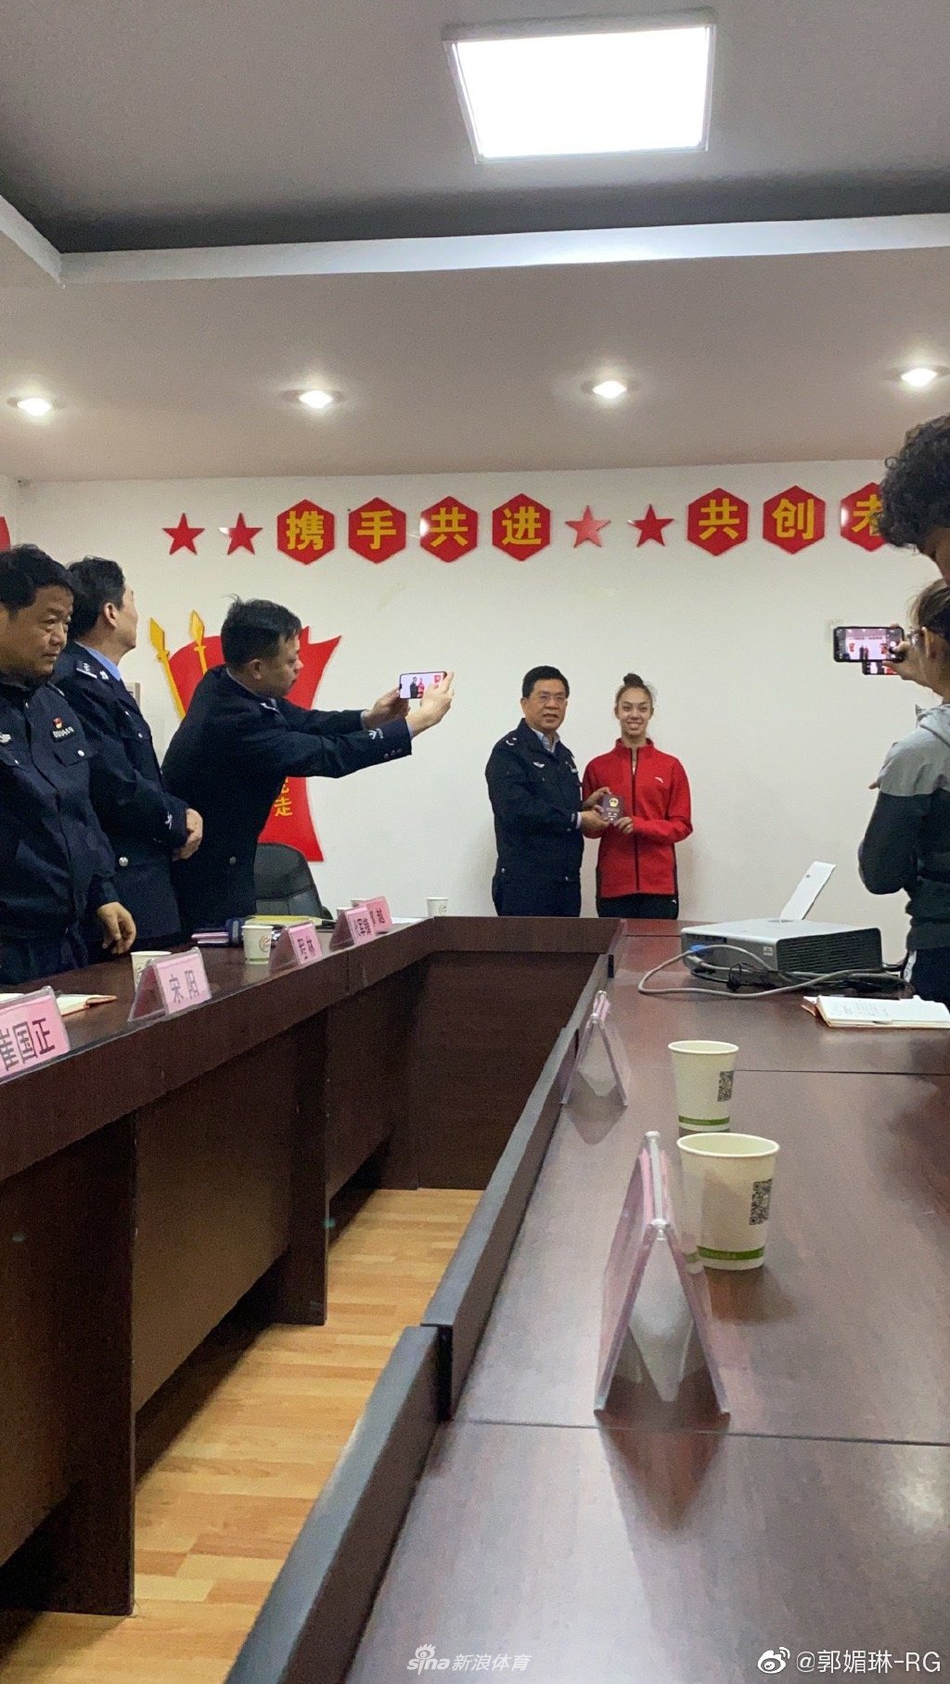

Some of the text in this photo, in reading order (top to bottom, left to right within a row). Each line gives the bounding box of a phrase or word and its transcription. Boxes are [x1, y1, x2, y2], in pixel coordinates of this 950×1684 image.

[286, 506, 542, 550] 携手共进
[169, 970, 200, 1003] 宋阳
